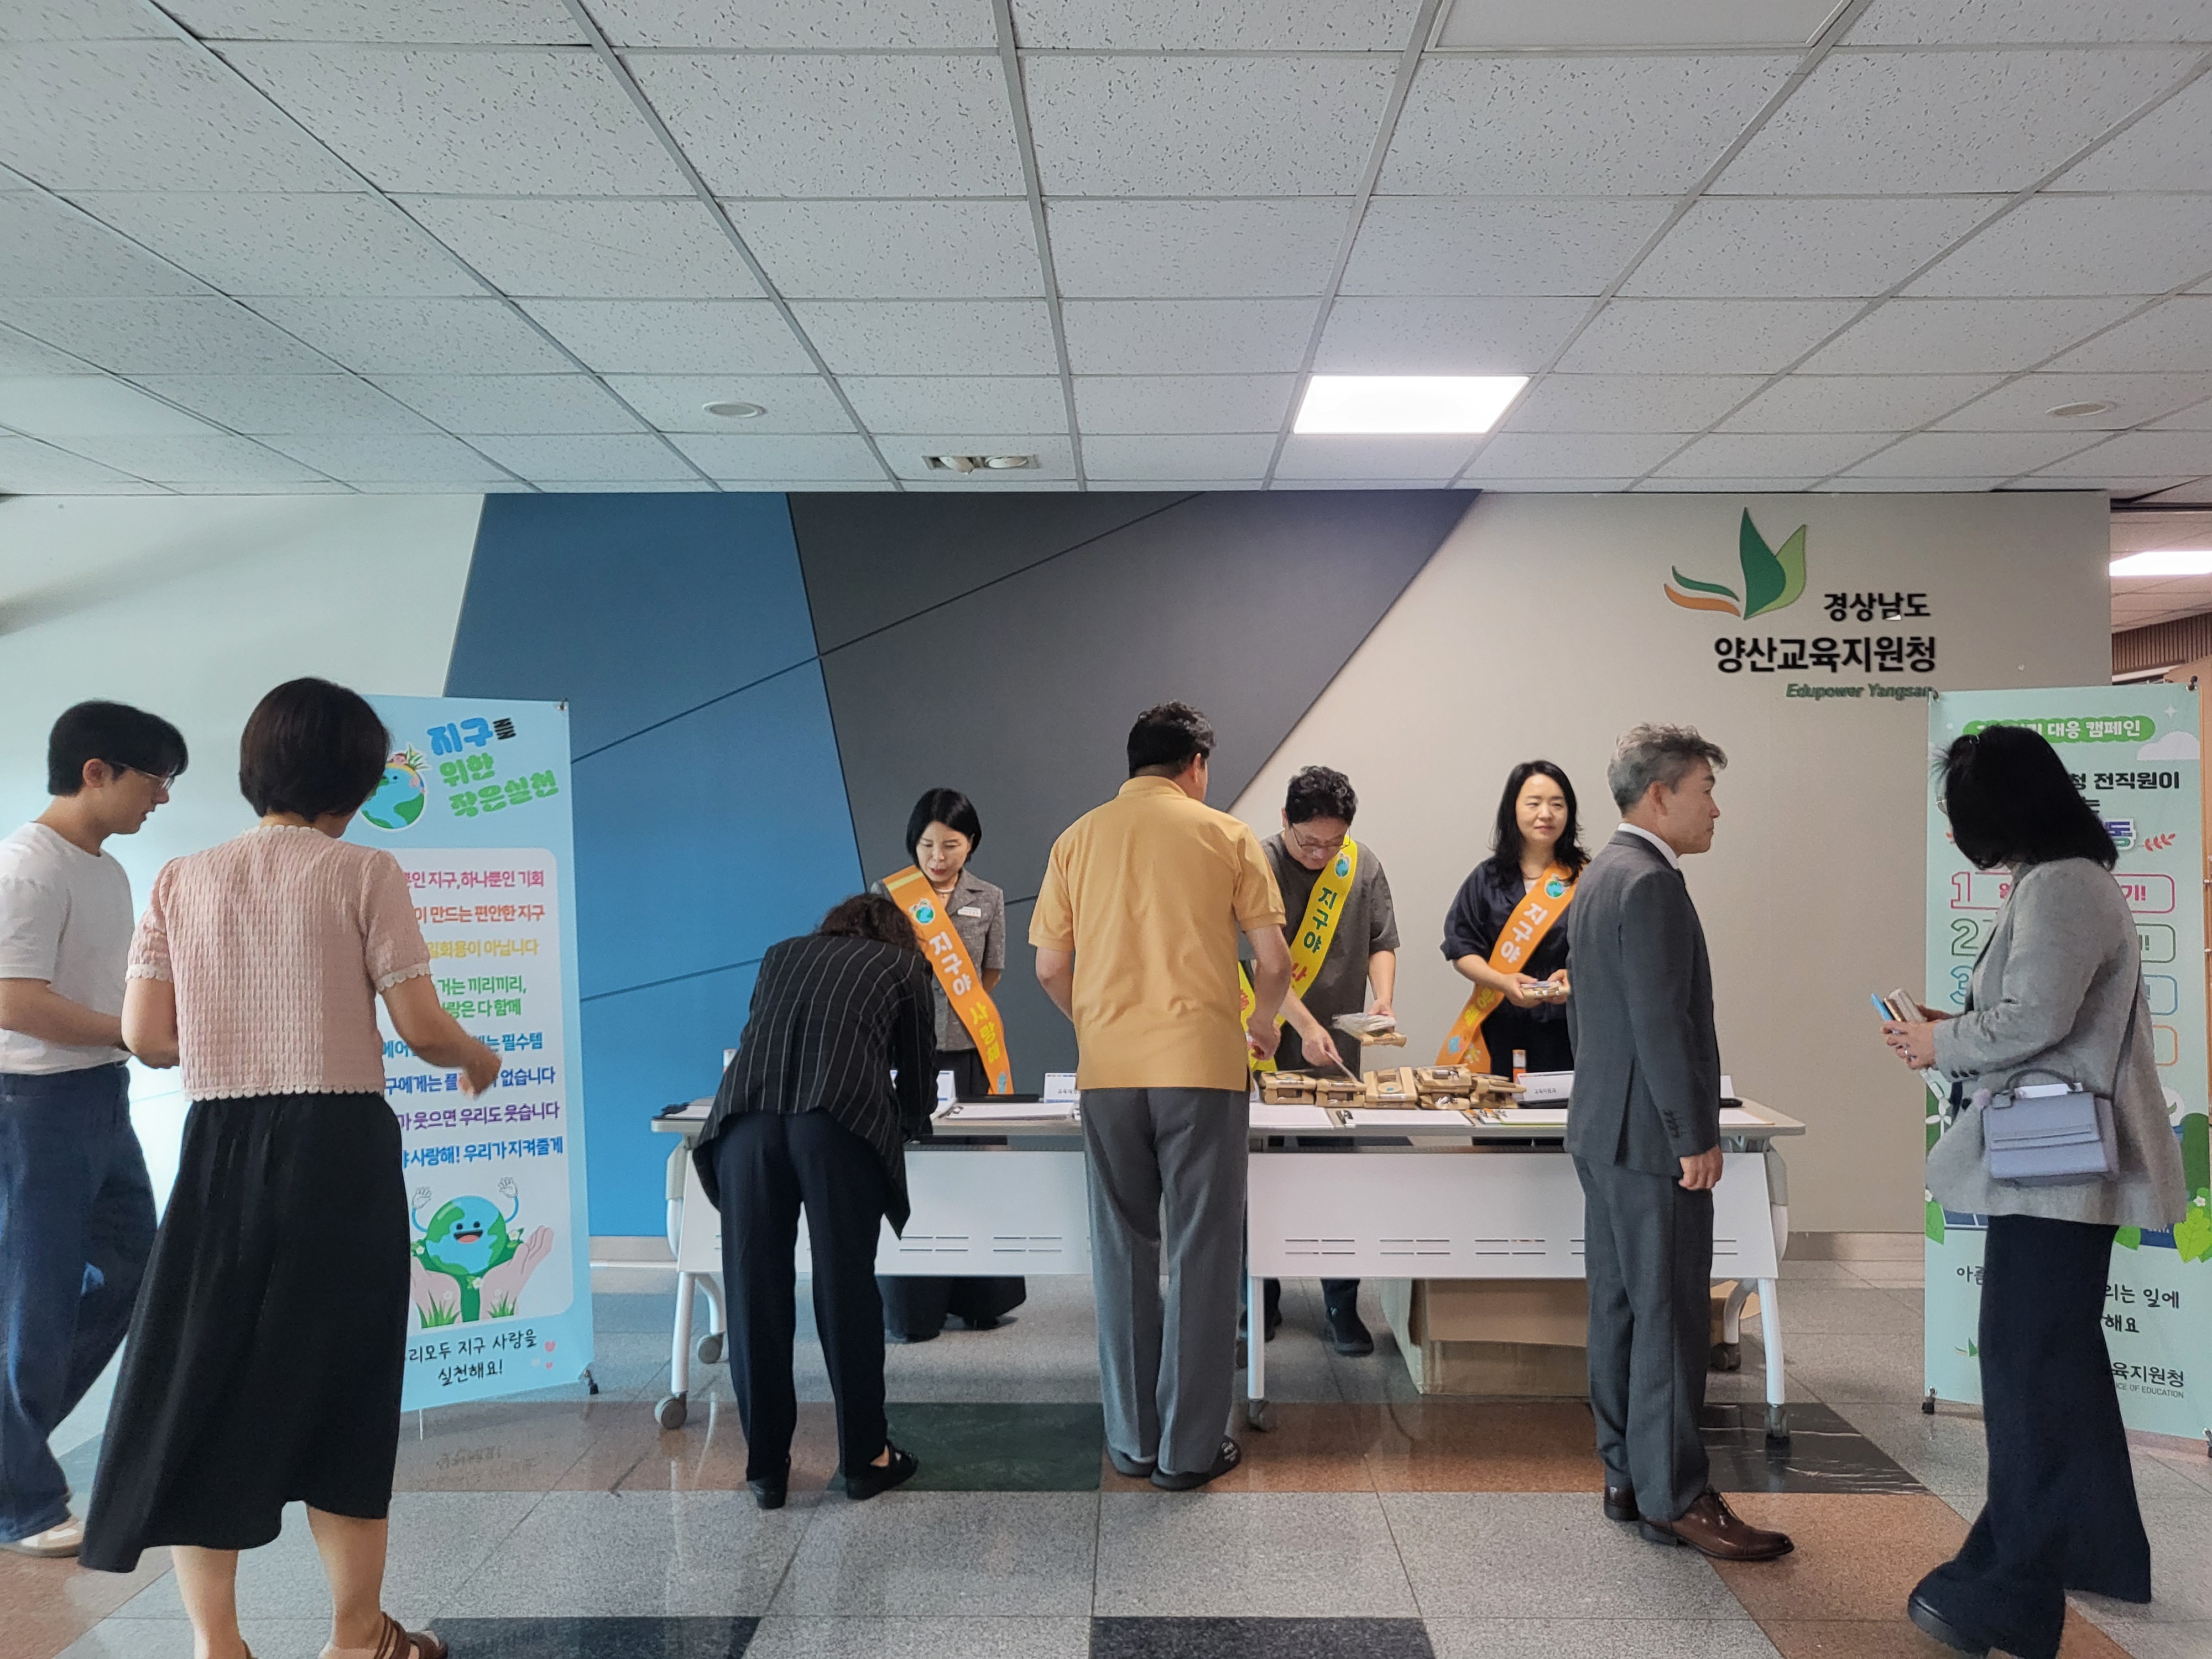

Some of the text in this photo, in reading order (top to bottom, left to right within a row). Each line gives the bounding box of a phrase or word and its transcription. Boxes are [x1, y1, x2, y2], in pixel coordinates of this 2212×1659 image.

[1824, 593, 1931, 622] 경상남도
[1714, 637, 1936, 673] 양산교육지원청
[1786, 684, 1865, 701] Edupower
[427, 718, 516, 755] 지구를
[2047, 721, 2080, 739] 대응
[2085, 720, 2140, 738] 캠페인
[440, 753, 495, 786] 위한
[2094, 771, 2179, 790] 전직원이
[449, 770, 559, 817] 작은실천
[518, 870, 544, 888] 기회
[430, 905, 472, 923] 만드는
[474, 904, 516, 922] 편안한
[518, 904, 545, 922] 지구
[1303, 886, 1338, 954] 지구야
[1501, 902, 1548, 963] 지구야
[1950, 918, 1979, 956] 2
[484, 938, 539, 956] 아닙니다
[929, 931, 971, 996] 지구야
[436, 975, 527, 996] 거는 끼리끼리,
[442, 998, 521, 1019] 랑은 다 함께
[502, 1032, 542, 1051] 필수템
[501, 1066, 555, 1087] 없습니다
[414, 1110, 456, 1129] 웃으면
[459, 1106, 502, 1126] 우리도
[504, 1101, 560, 1122] 웃습니다
[411, 1145, 460, 1167] 사랑해!
[464, 1141, 507, 1162] 우리가
[509, 1136, 563, 1158] 지켜줄게
[2143, 1288, 2179, 1309] 일에
[406, 1329, 536, 1363] 리모두 지구 사랑을
[438, 1359, 503, 1386] 실천해요!
[2142, 1386, 2184, 1398] EDUCATION
